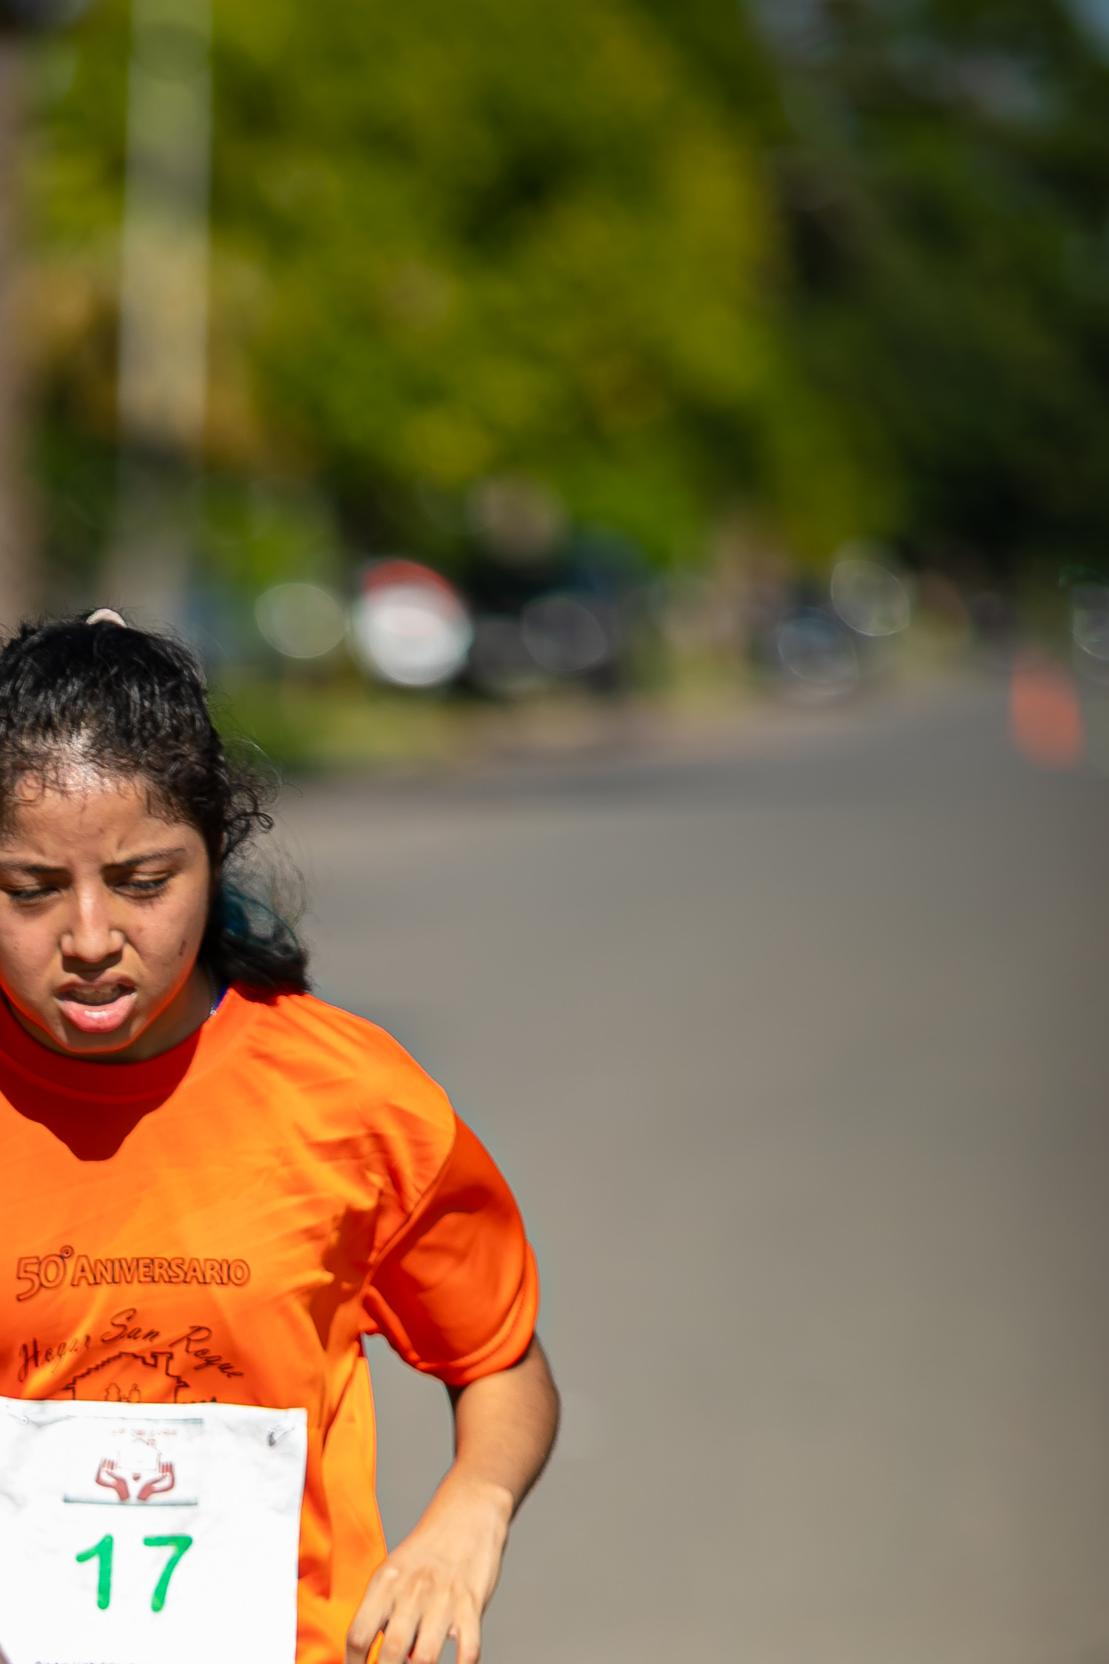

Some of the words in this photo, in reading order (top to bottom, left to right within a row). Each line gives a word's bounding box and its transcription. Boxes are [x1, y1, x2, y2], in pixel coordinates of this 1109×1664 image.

[71, 1255, 251, 1287] ANIVERSARIO
[100, 1308, 161, 1343] San
[169, 1326, 245, 1380] Roque
[76, 1534, 193, 1613] 17
